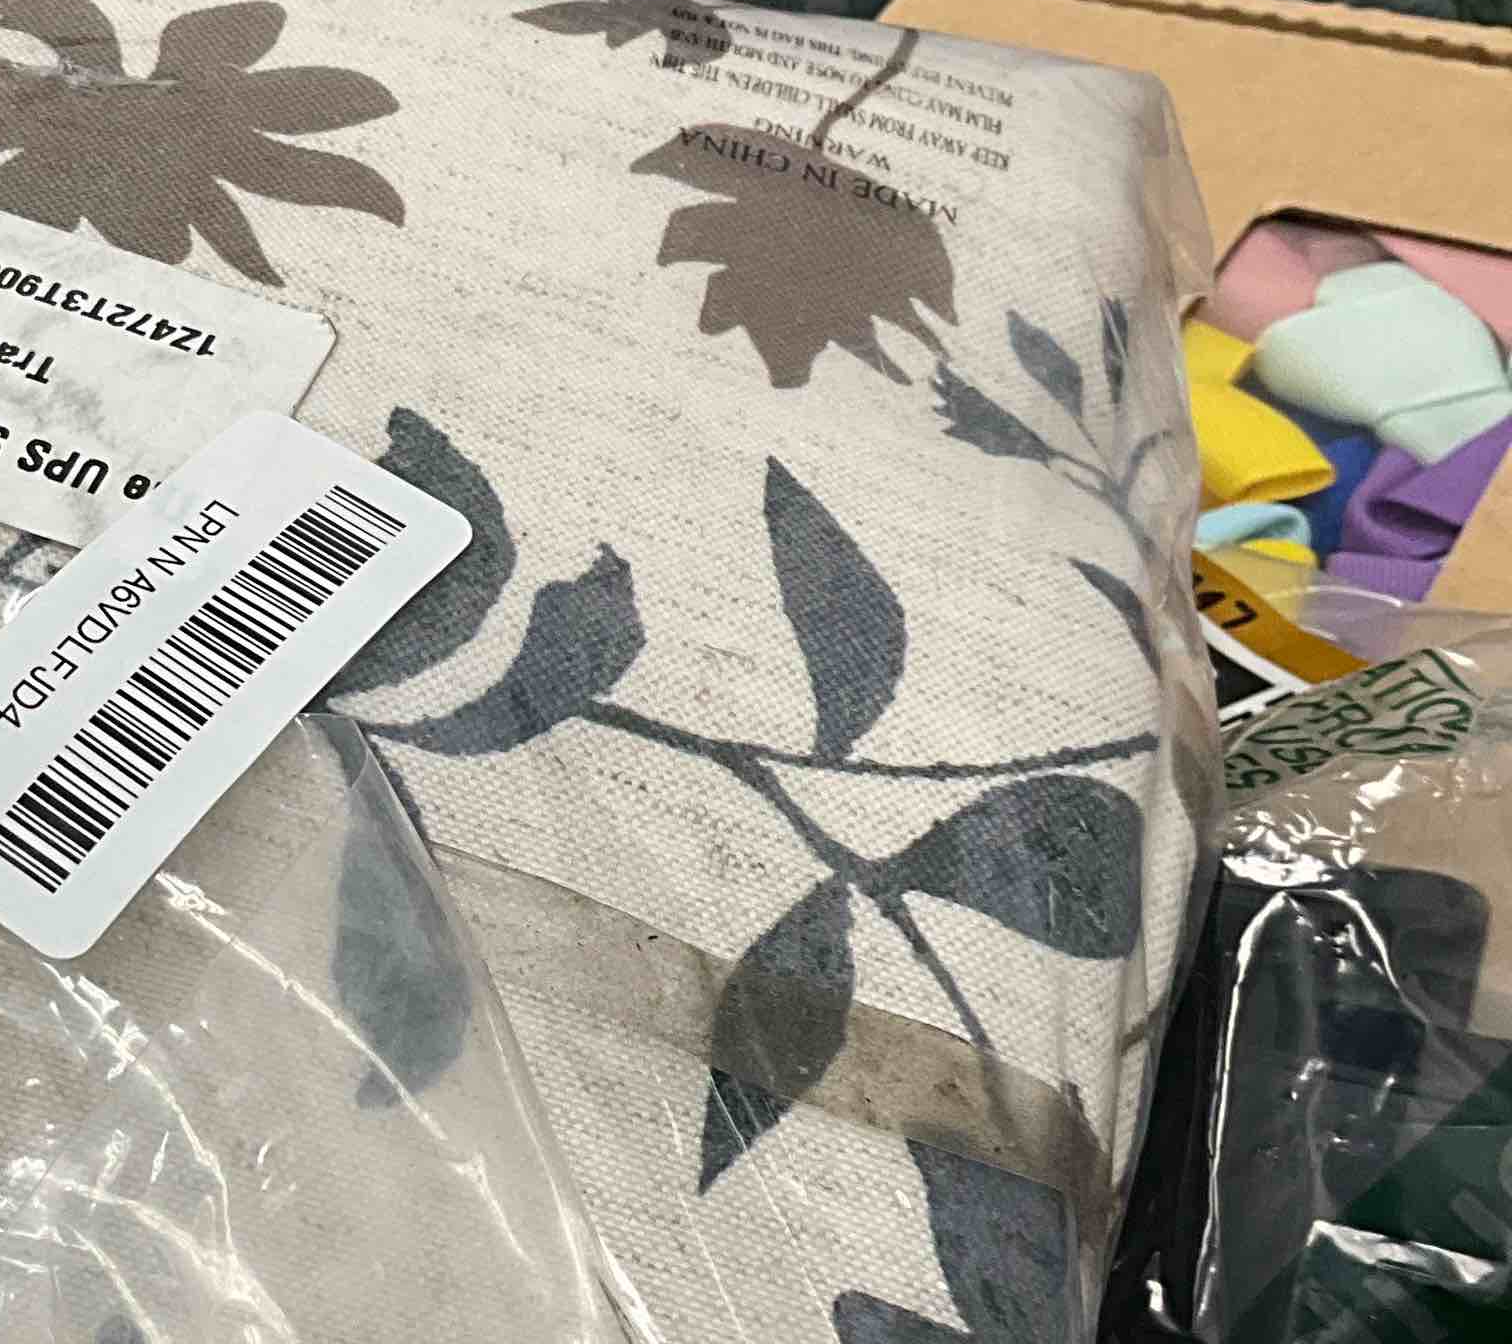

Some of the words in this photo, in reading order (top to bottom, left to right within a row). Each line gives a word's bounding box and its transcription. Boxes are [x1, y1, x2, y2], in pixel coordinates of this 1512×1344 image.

[866, 108, 918, 143] FROM
[925, 96, 964, 122] MAY
[964, 107, 1004, 136] FILM
[679, 126, 790, 174] CHINA
[752, 115, 892, 172] WARNING
[918, 124, 973, 161] AWAY
[974, 143, 1011, 173] KEEP
[802, 159, 842, 190] IN
[851, 174, 959, 226] MADE
[15, 439, 110, 496] UPS
[186, 498, 241, 557] LPN
